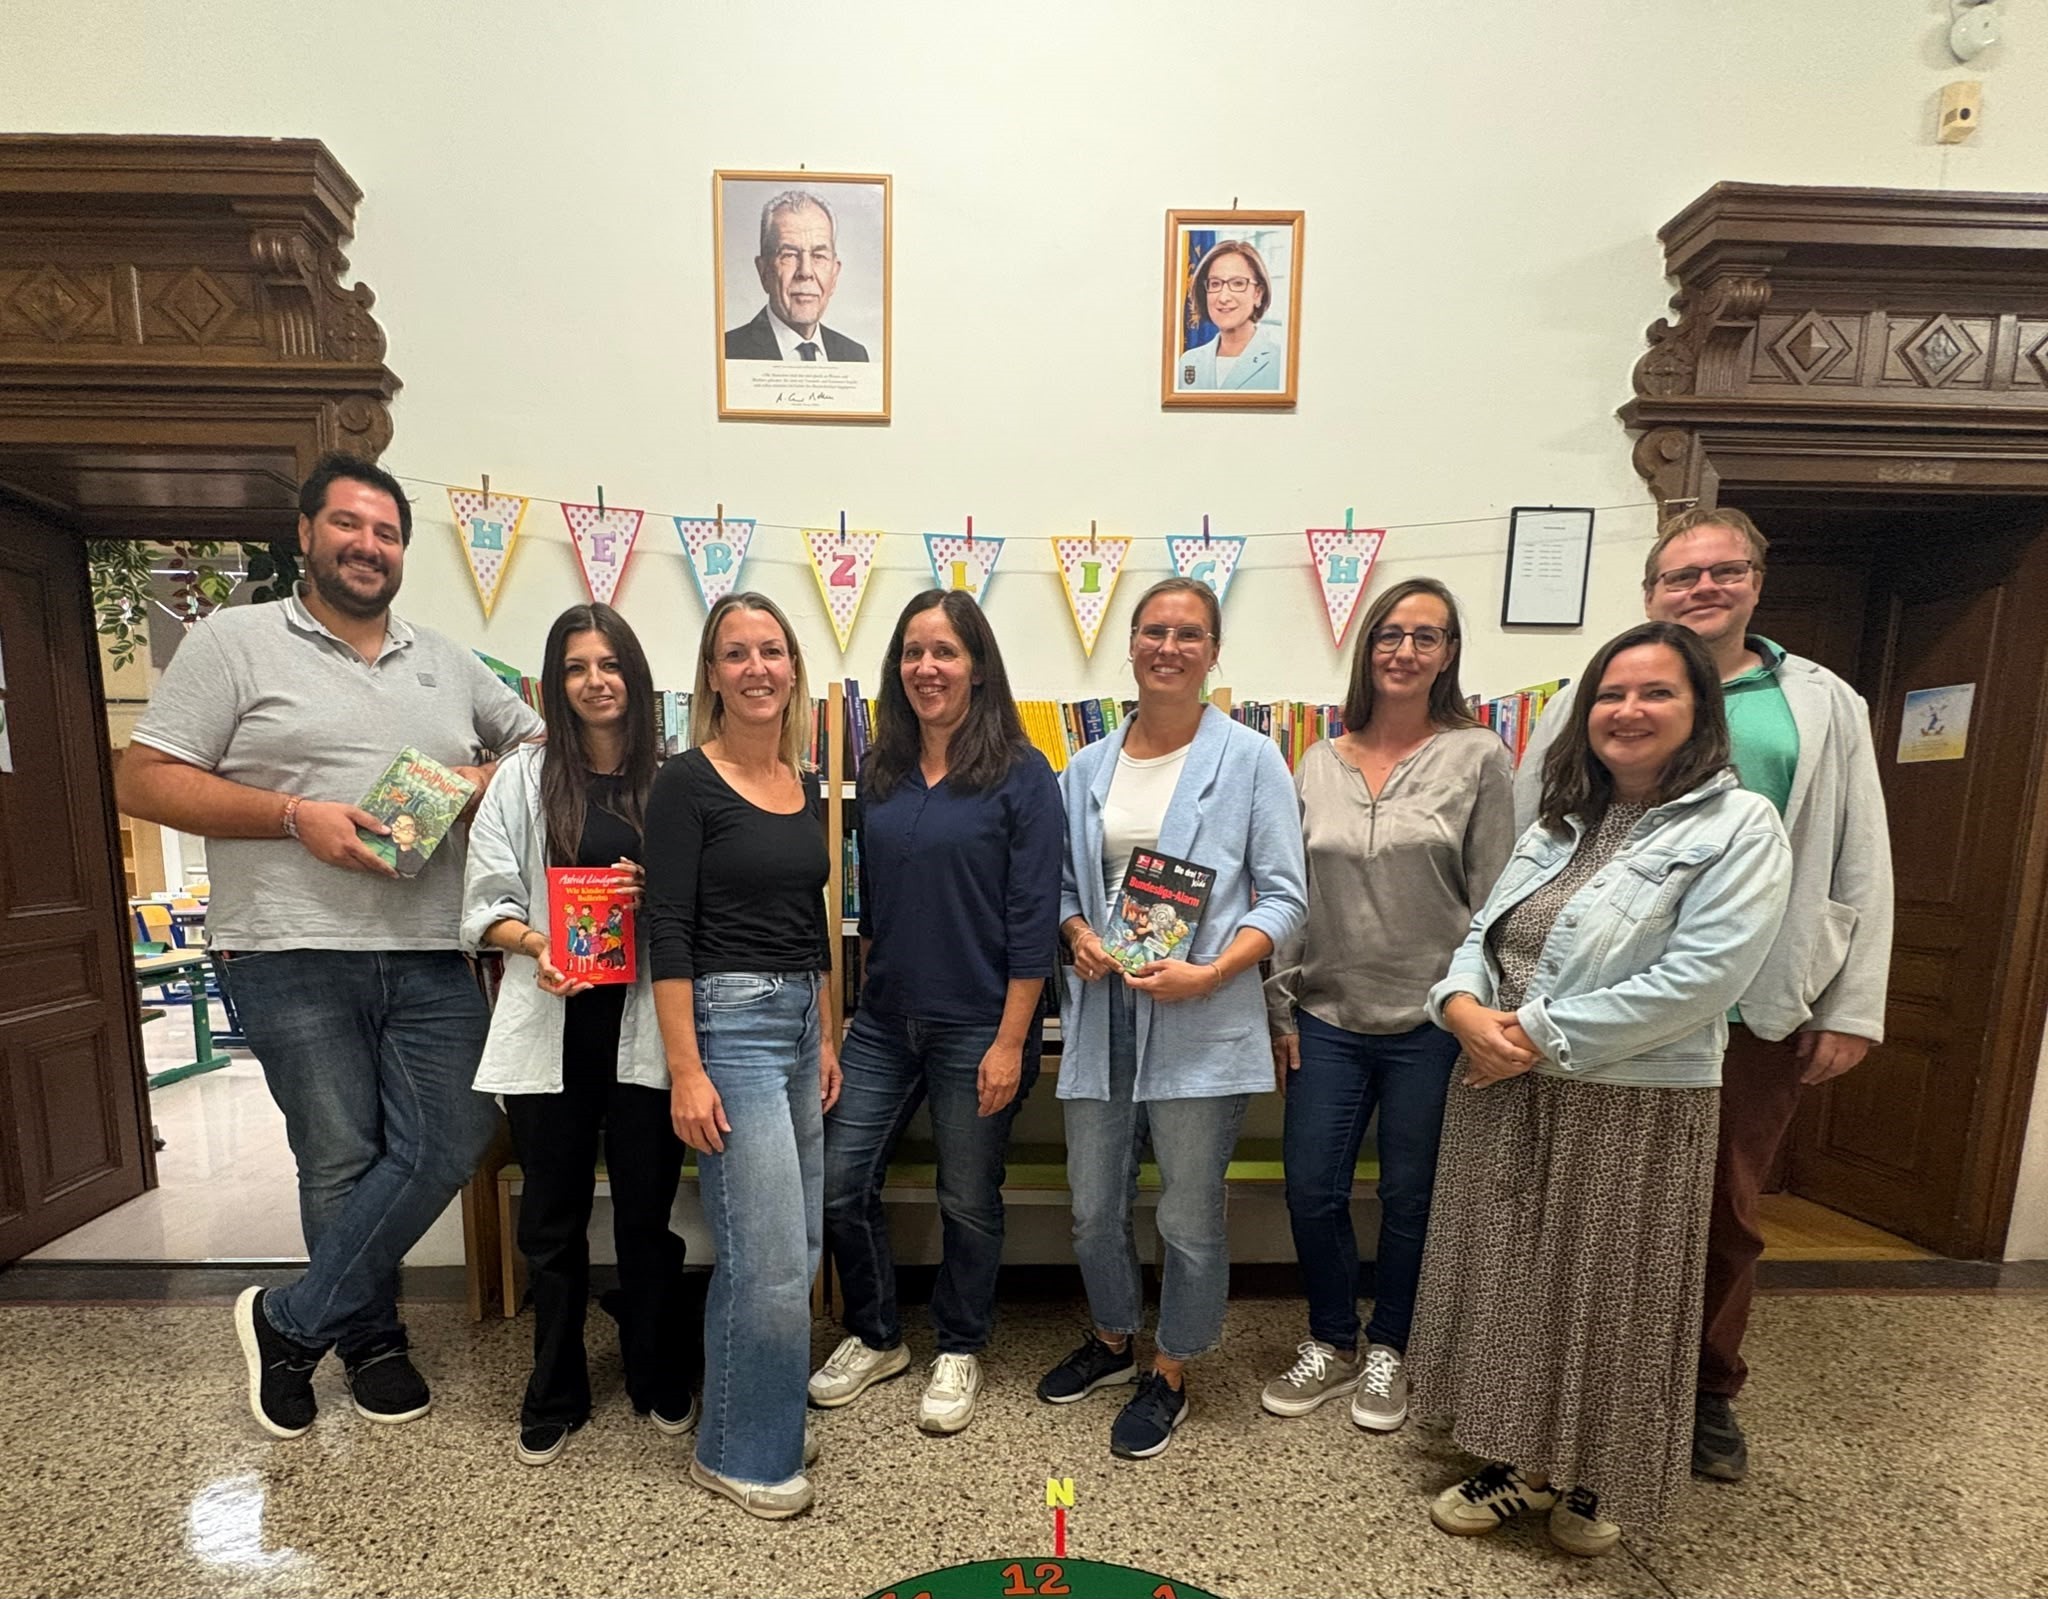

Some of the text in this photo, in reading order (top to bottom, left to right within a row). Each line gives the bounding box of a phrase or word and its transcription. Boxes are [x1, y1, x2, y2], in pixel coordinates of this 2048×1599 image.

[560, 874, 586, 885] Astrid
[581, 887, 606, 895] Kinder
[1129, 876, 1200, 907] Bundesliga-Alarm
[1045, 1477, 1075, 1507] N
[1000, 1562, 1072, 1596] 12
